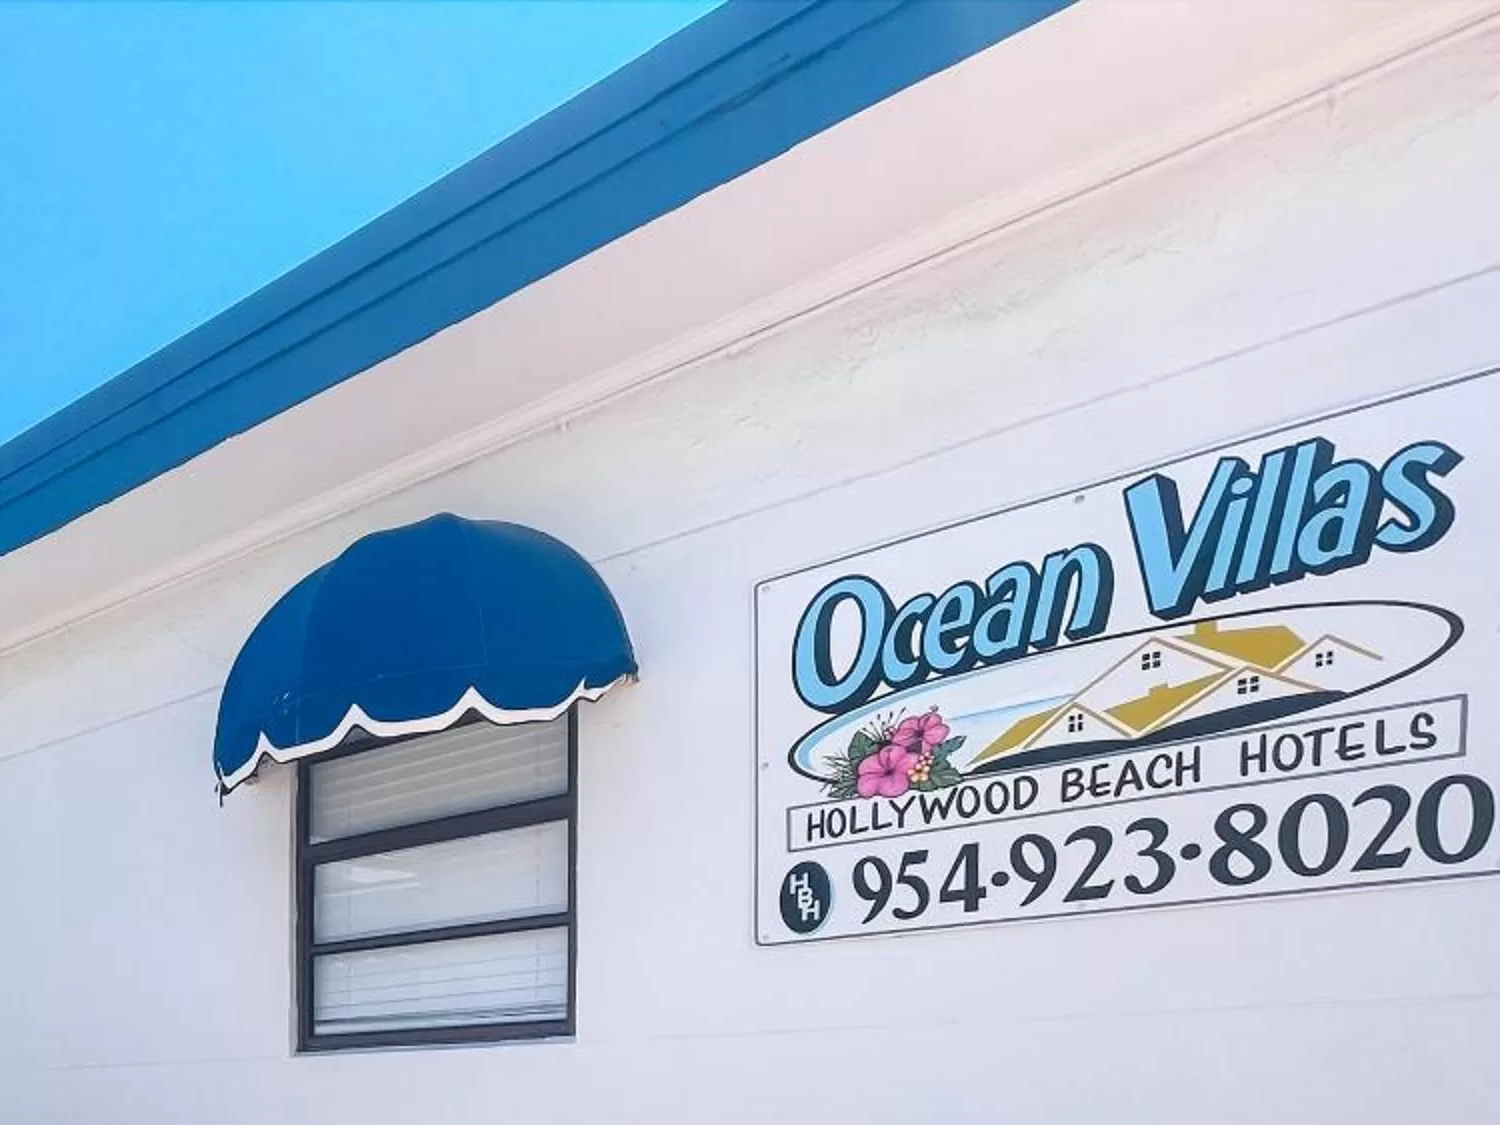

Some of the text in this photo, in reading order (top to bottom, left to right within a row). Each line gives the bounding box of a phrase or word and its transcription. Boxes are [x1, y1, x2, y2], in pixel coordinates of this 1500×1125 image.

[792, 437, 1464, 712] Ocean Villas
[806, 712, 1438, 842] HOLLYWOOD BEACH HOTELS
